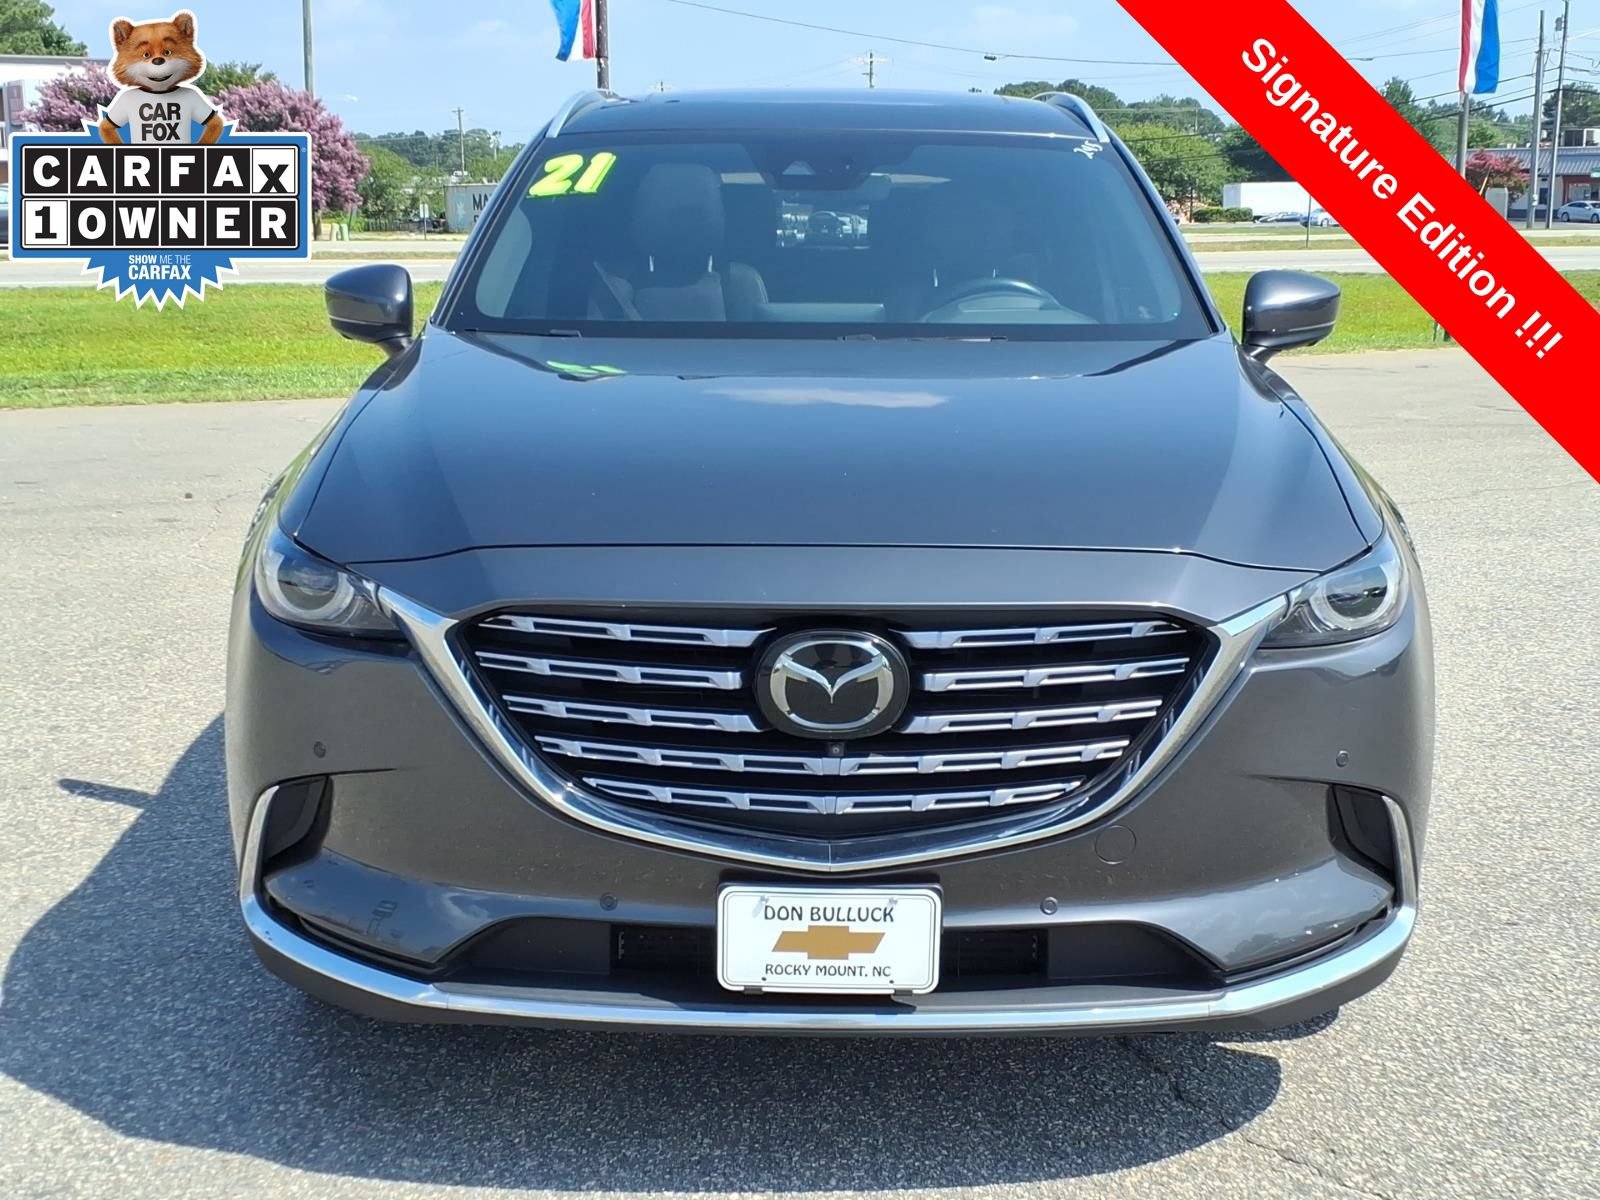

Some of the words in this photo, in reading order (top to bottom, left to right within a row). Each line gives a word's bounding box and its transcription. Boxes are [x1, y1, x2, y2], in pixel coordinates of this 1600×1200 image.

[527, 152, 616, 197] 21
[764, 905, 803, 921] DON
[809, 905, 895, 923] BULLUCK
[765, 963, 811, 976] ROCKY
[872, 965, 891, 977] NC
